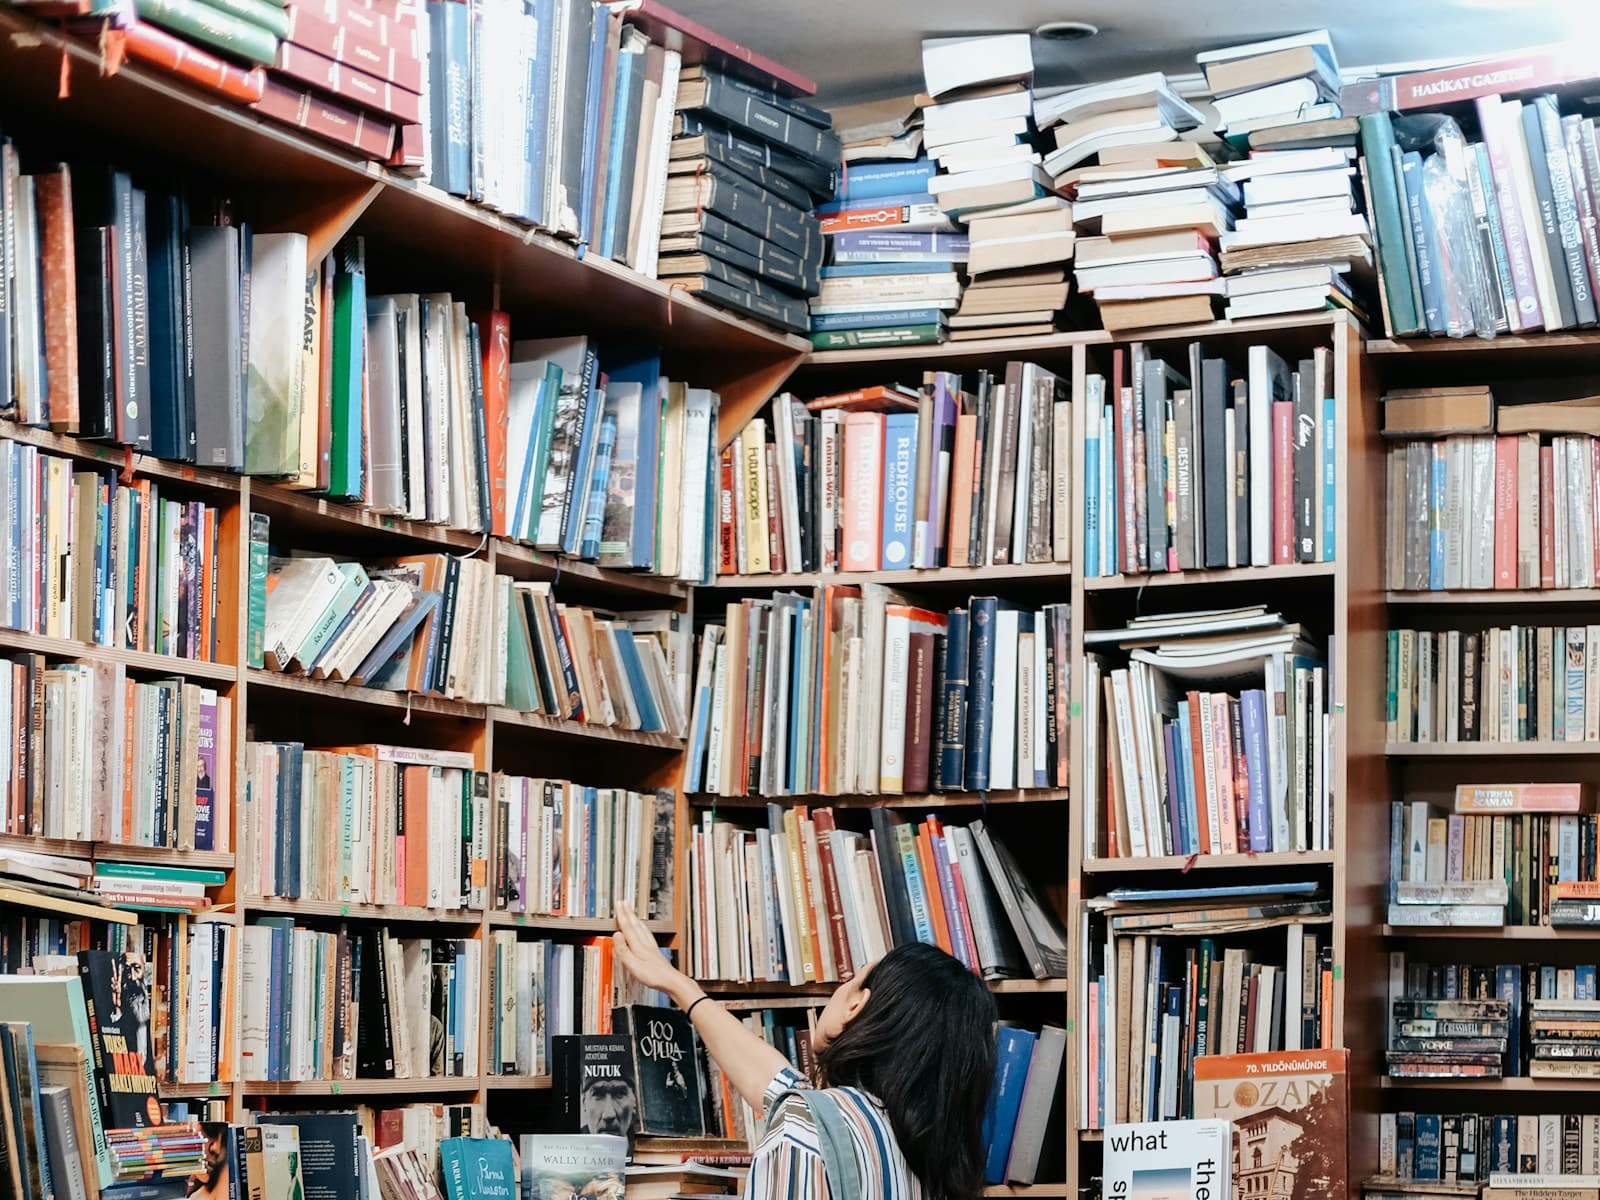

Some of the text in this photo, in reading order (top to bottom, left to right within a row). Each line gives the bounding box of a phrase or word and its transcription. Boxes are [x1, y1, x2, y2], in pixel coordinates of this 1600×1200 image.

[1412, 77, 1470, 97] HAKİKAT
[446, 60, 463, 143] Electronic
[1542, 199, 1554, 233] DAMAT
[1571, 252, 1587, 301] OSMANLI
[126, 294, 134, 304] VE
[749, 446, 764, 521] Futurescapes
[825, 436, 834, 509] Animal-Wise
[1178, 447, 1189, 497] DESTANIN
[895, 436, 911, 534] REDHOUSE
[33, 667, 44, 732] dinler tarihi
[648, 1019, 674, 1041] 100
[1238, 1015, 1247, 1042] FATHER
[584, 1044, 626, 1052] MUSTAFA KEMAL
[584, 1052, 608, 1061] ATATÜRK
[641, 1036, 688, 1061] OPERA
[1420, 1040, 1454, 1050] YORKE
[113, 1051, 147, 1075] MARX
[584, 1064, 622, 1078] NUTUK
[1245, 1059, 1328, 1073] 70. YILDÖNÜMÜNDE
[1213, 1079, 1328, 1110] LOZAN
[1111, 1129, 1168, 1152] what
[543, 1154, 616, 1166] WALLY LAMB
